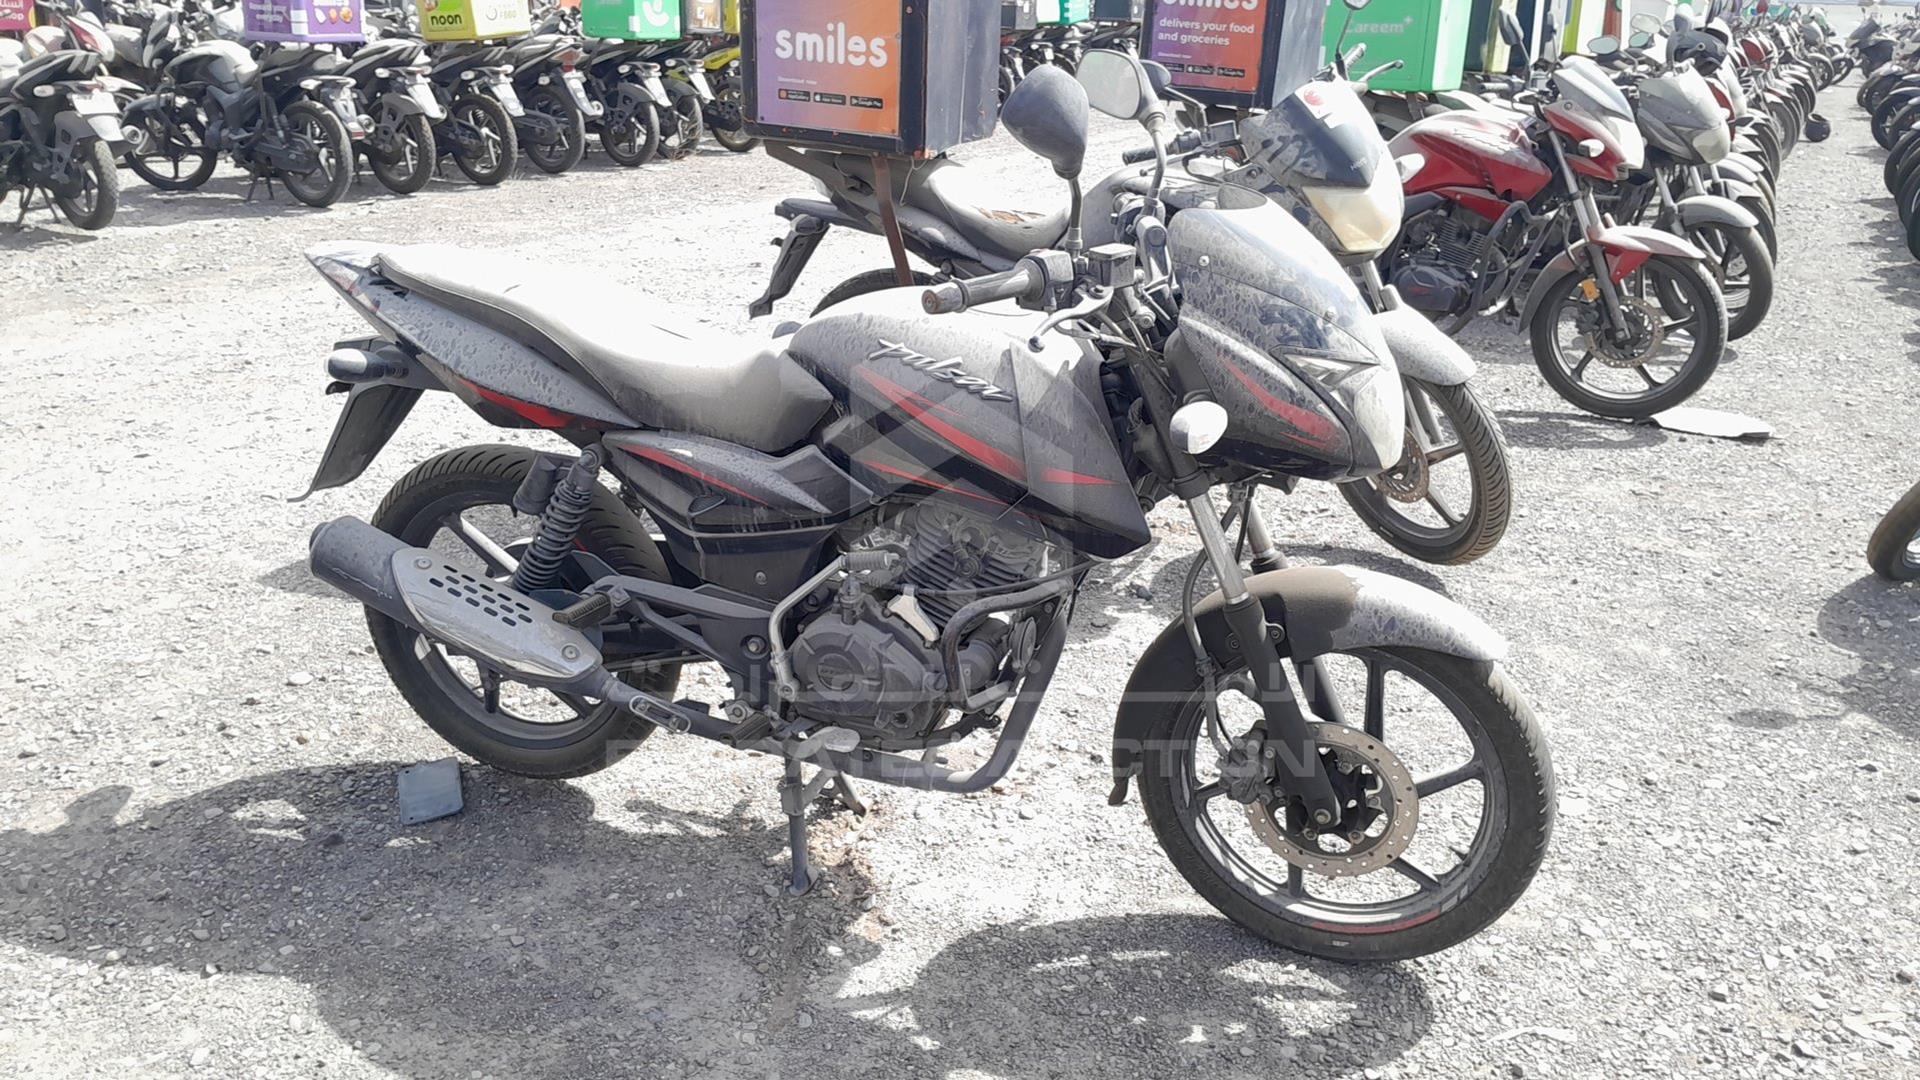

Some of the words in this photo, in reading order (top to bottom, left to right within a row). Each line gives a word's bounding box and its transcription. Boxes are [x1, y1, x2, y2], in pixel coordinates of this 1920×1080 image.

[430, 14, 463, 26] noon
[1159, 17, 1201, 29] delivers
[1202, 21, 1227, 32] your
[1228, 22, 1255, 33] food
[775, 22, 888, 68] smiles
[1157, 32, 1178, 41] and
[1179, 35, 1230, 46] groceries
